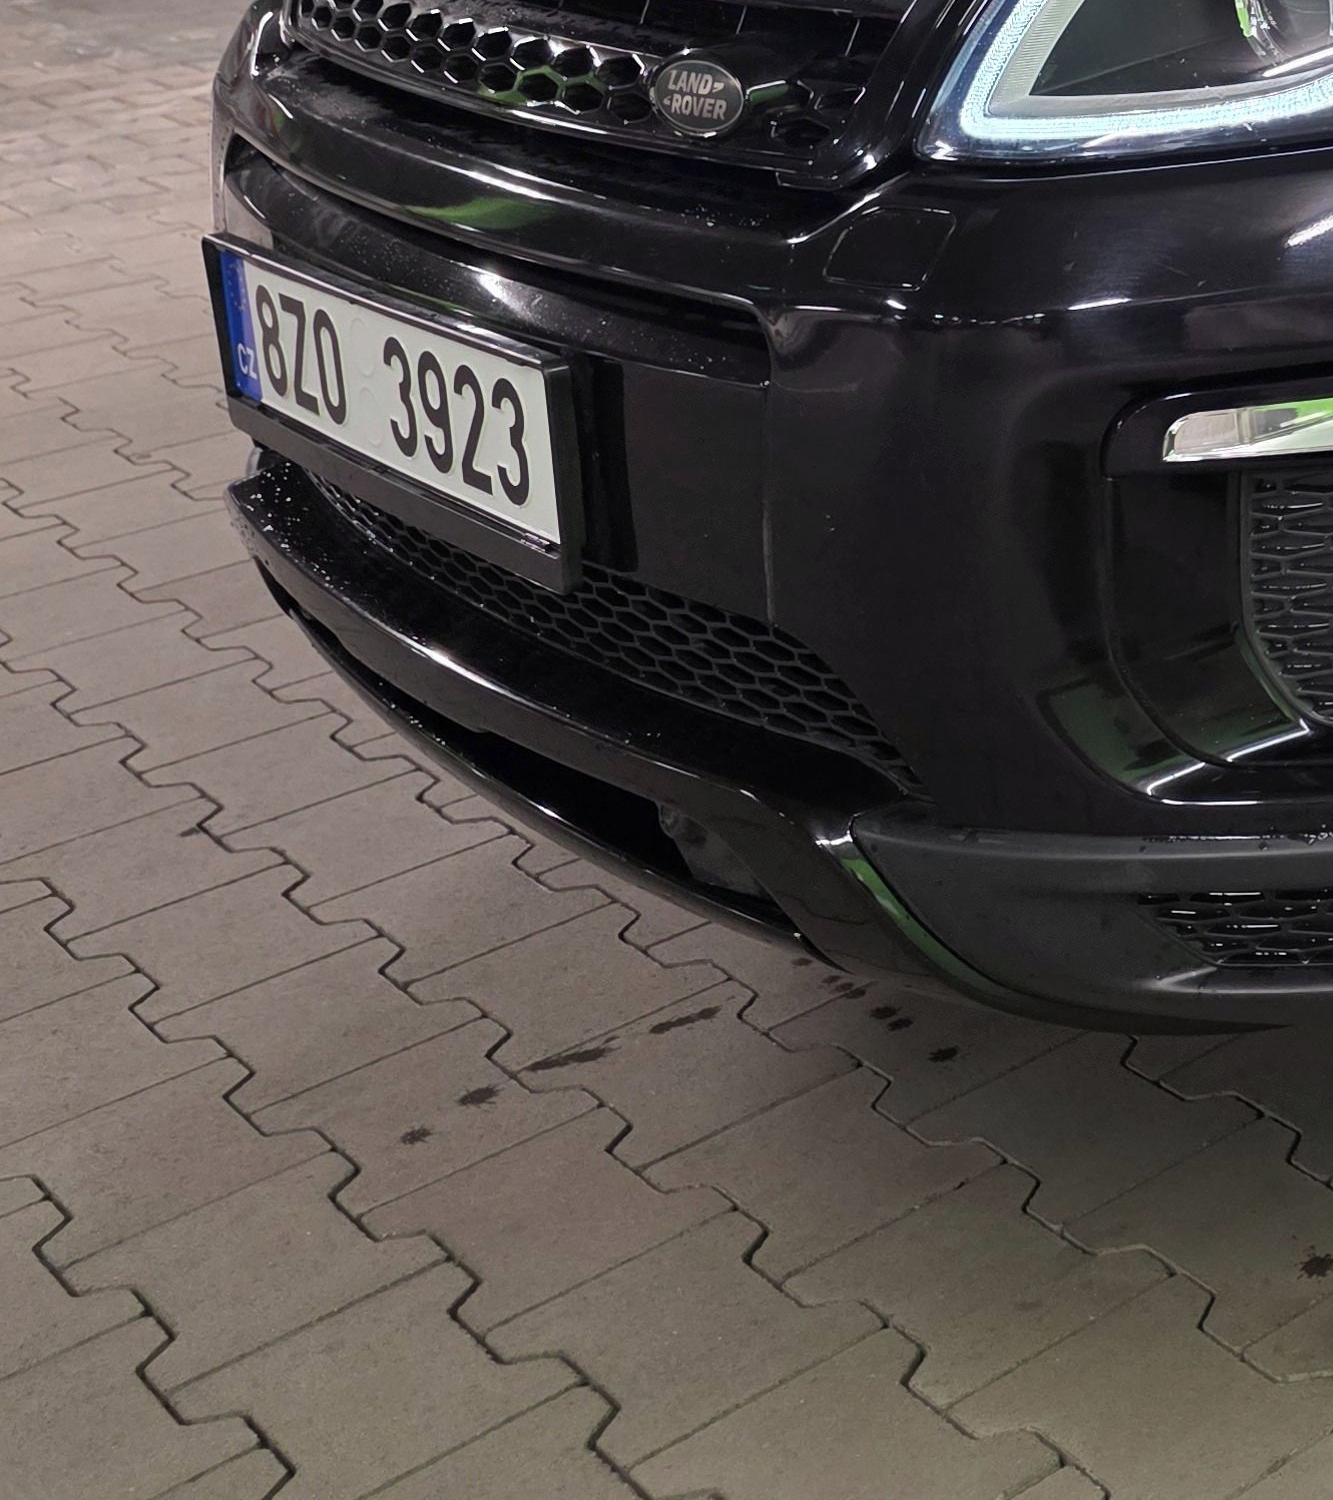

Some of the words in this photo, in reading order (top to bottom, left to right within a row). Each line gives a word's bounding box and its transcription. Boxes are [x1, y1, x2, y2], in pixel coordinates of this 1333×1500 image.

[667, 69, 713, 95] LAND
[671, 93, 727, 120] ROVER
[237, 342, 258, 381] CZ
[382, 335, 530, 507] 3923
